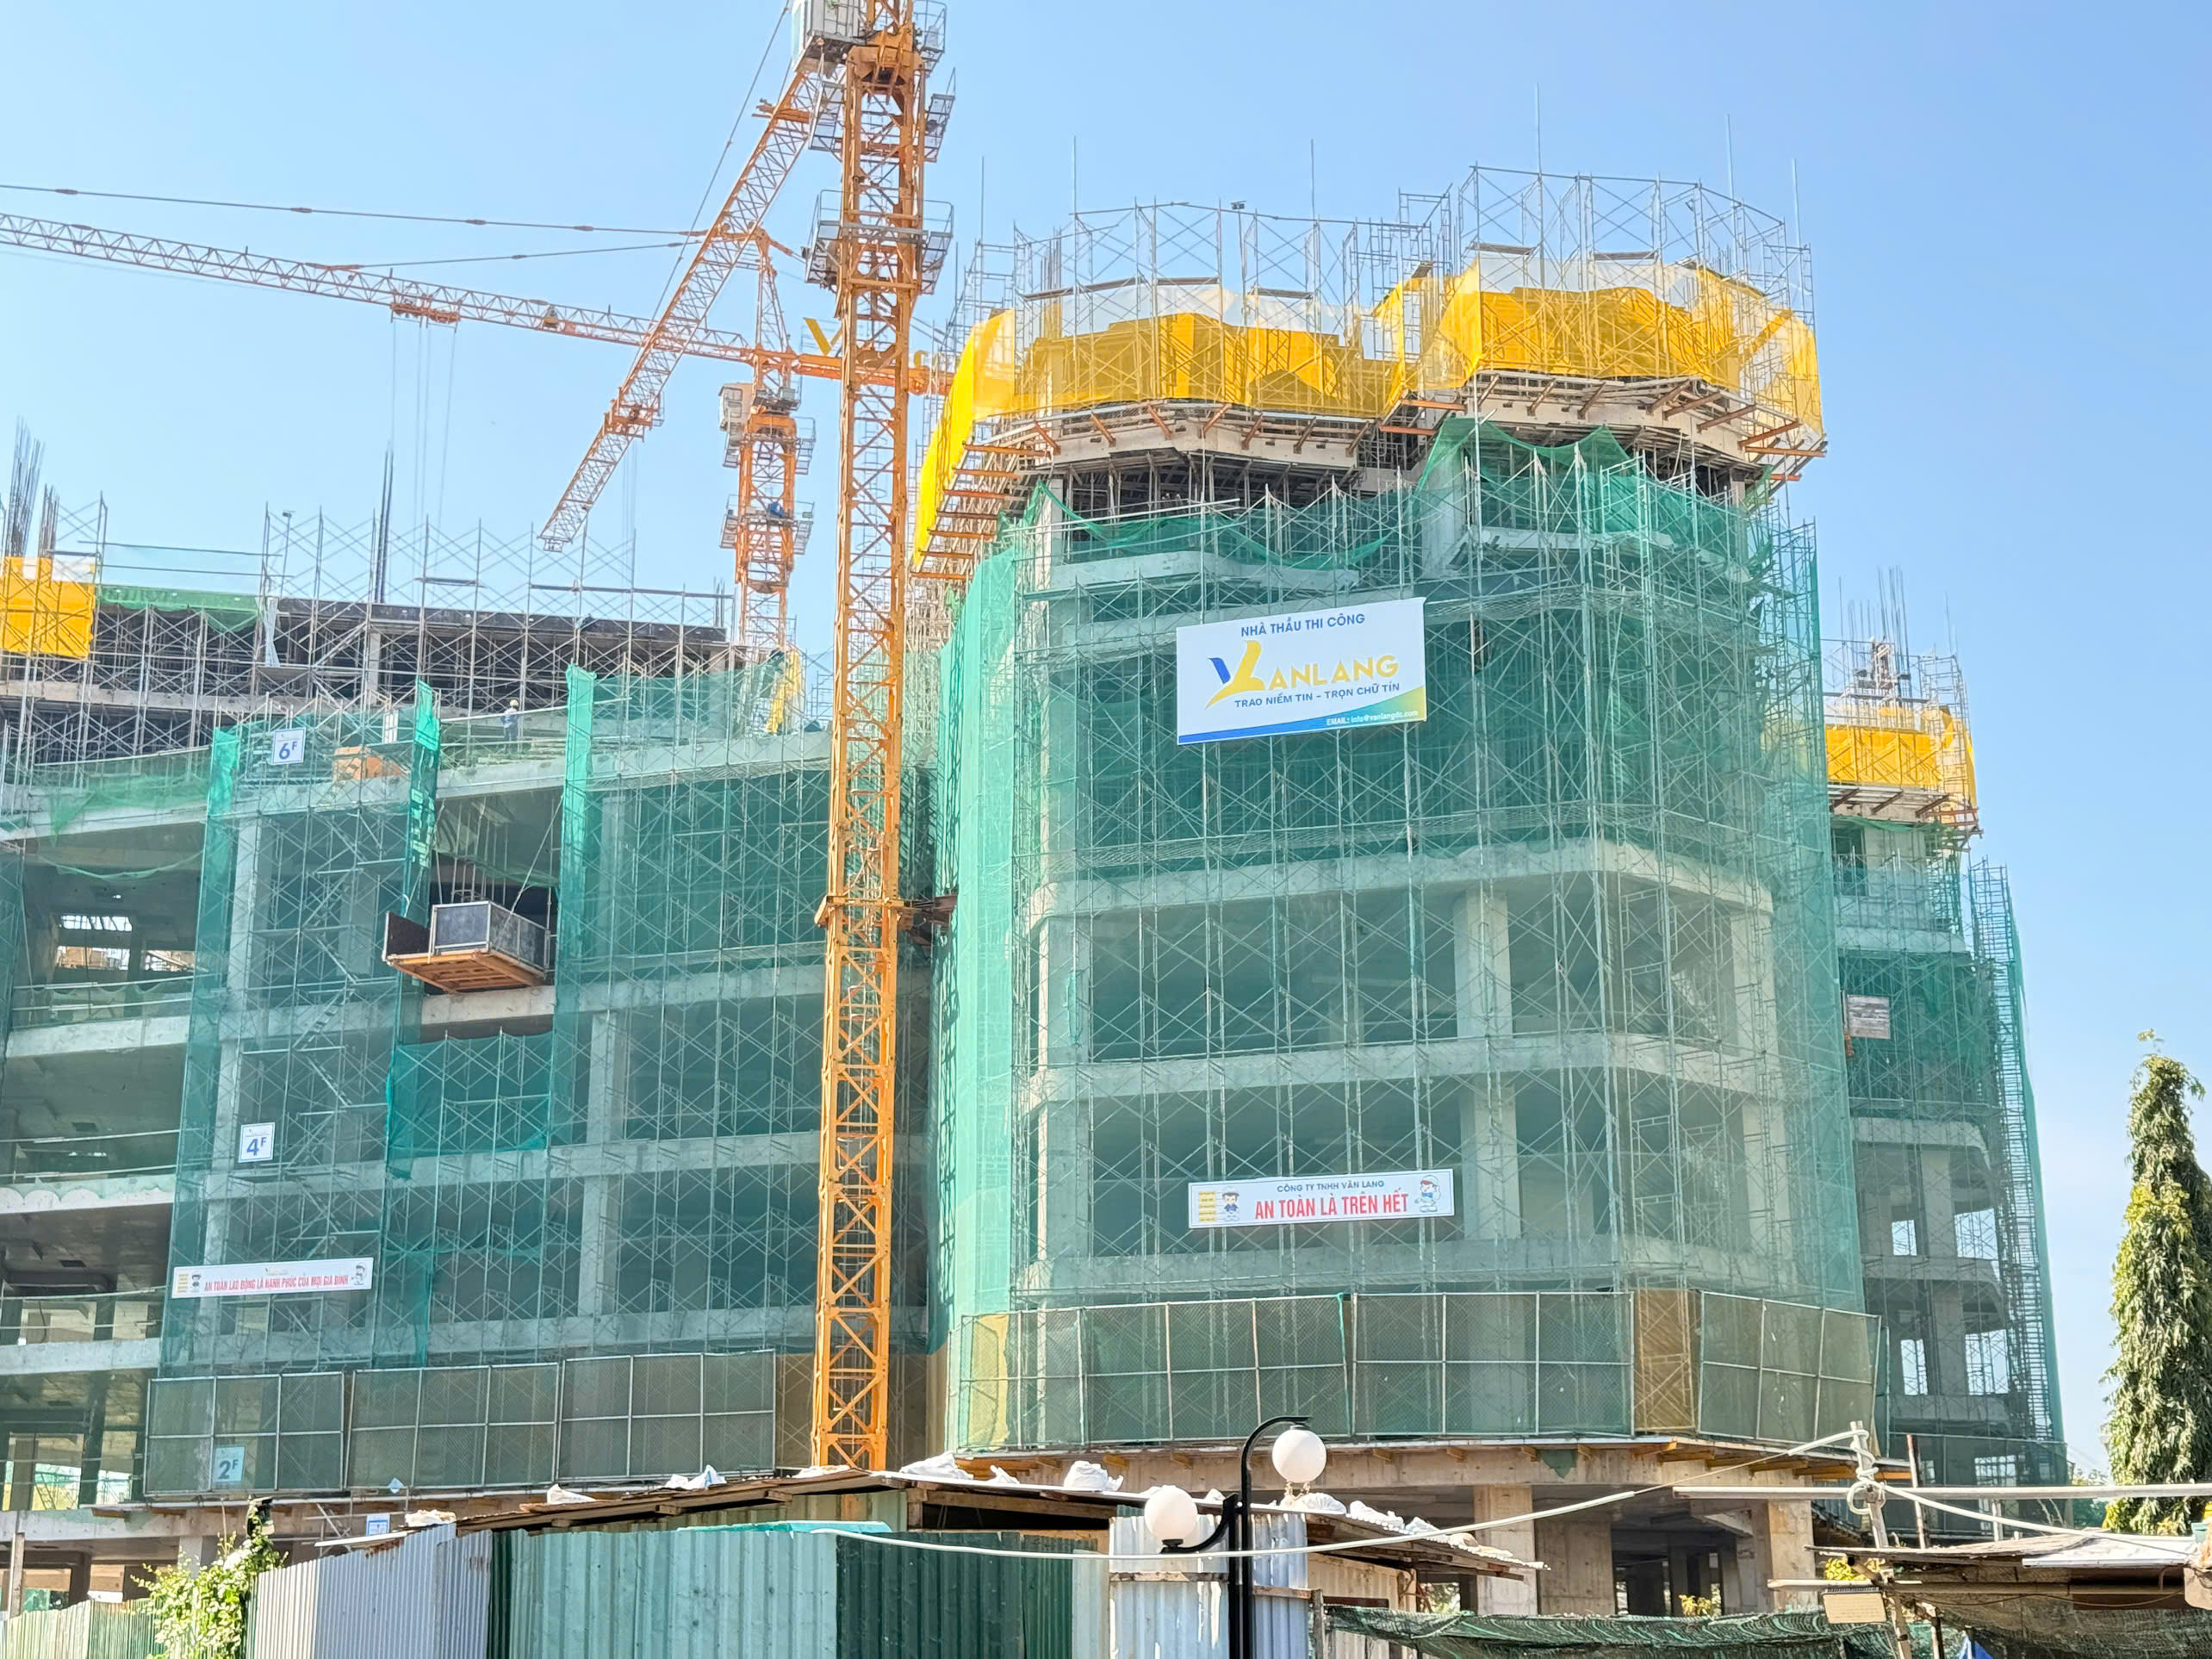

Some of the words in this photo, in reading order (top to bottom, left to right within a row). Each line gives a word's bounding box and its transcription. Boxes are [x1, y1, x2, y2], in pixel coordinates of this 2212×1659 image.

[1240, 621, 1267, 637] NHÀ
[1305, 618, 1323, 630] THI
[1327, 612, 1365, 627] CÔNG
[1234, 698, 1263, 708] TRAO
[1296, 693, 1313, 702] TIN
[1324, 688, 1353, 699] TRỌN
[1277, 1183, 1303, 1193] CÔNG
[1305, 1183, 1315, 1191] TY
[1316, 1182, 1339, 1190] TNHH
[1361, 1179, 1385, 1189] LANG
[1254, 1200, 1275, 1220] AN
[1278, 1194, 1316, 1218] TOÀN
[1320, 1192, 1338, 1216] LÀ
[1341, 1190, 1379, 1215] TRÊN
[1382, 1187, 1409, 1214] HẾT
